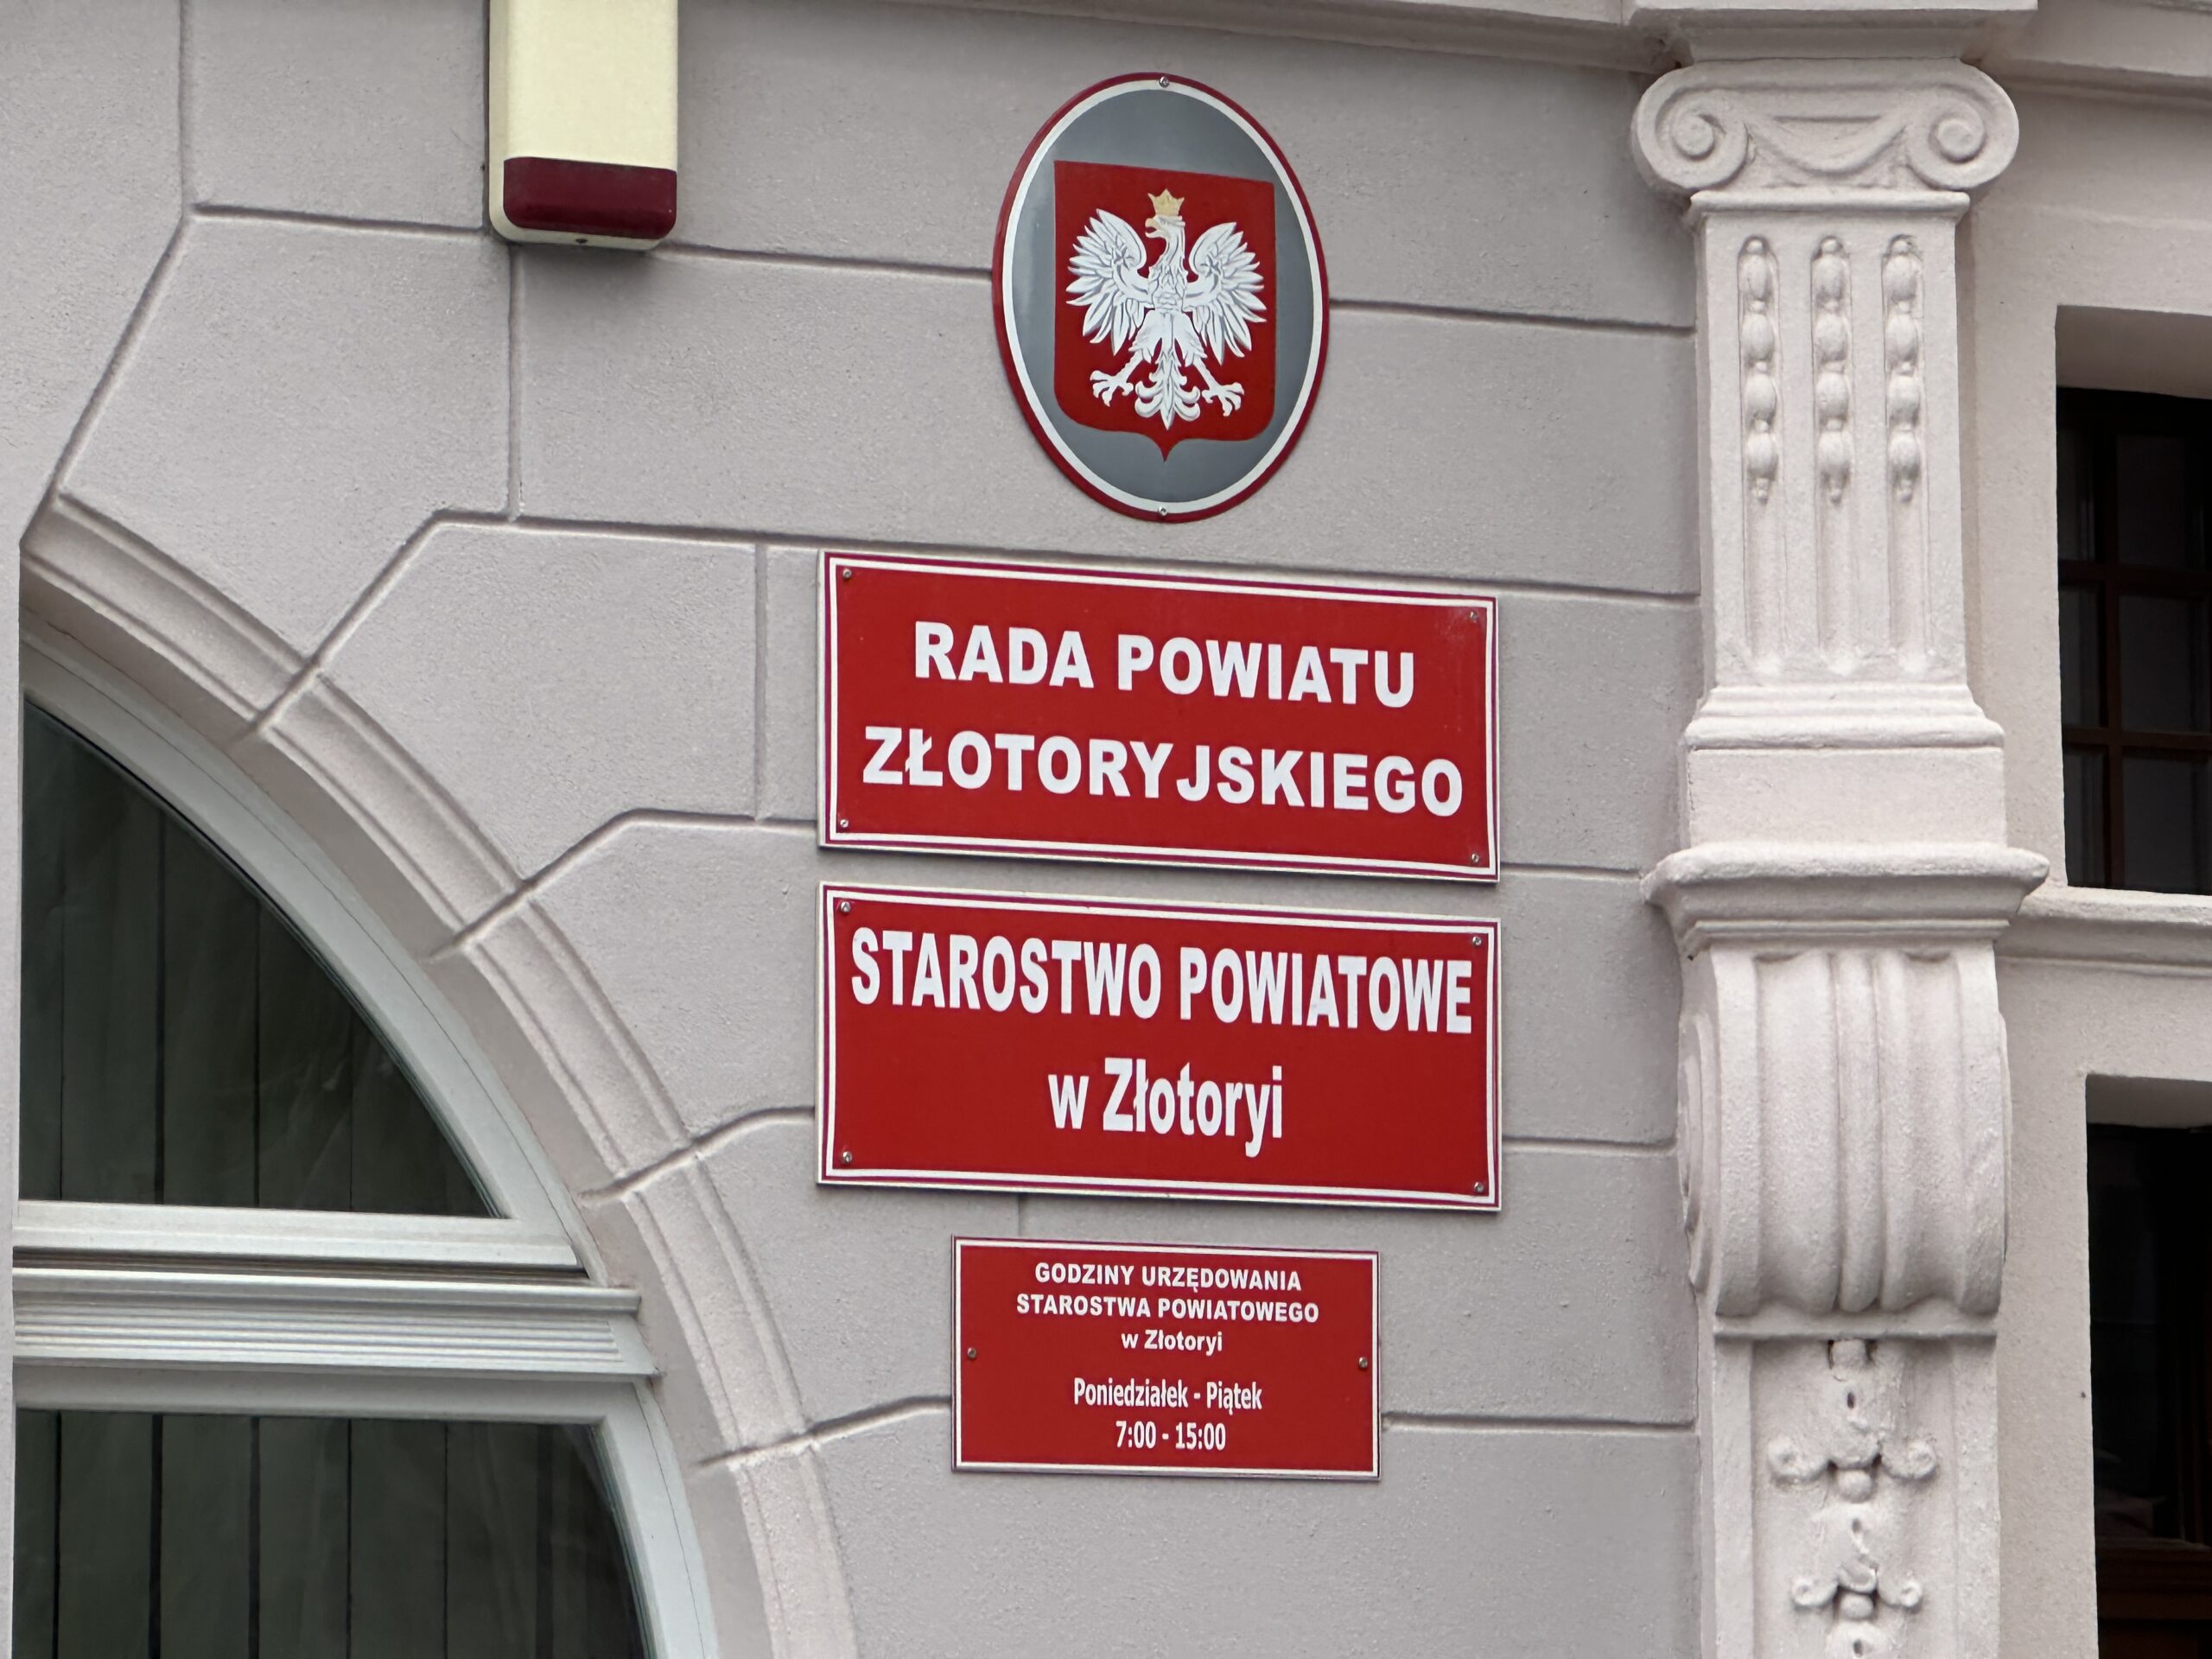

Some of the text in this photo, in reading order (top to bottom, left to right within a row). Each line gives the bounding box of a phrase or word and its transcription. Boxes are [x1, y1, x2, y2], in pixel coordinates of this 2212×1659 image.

[916, 621, 1414, 708] RADA POWIATU
[863, 727, 1462, 817] ZŁOTORYJSKIEGO
[852, 927, 1471, 1033] STAROSTWO POWIATOWE
[1048, 1058, 1281, 1157] w Złotoryi
[1035, 1262, 1301, 1293] GODZINY URZĘDOWANIA
[1017, 1294, 1319, 1322] STAROSTWA POWIATOWEGO
[1122, 1330, 1222, 1356] w Złotoryi
[1074, 1377, 1188, 1408] Poniedziałek
[1207, 1381, 1262, 1415] Piątek
[1116, 1421, 1156, 1448] 7:00
[1176, 1422, 1225, 1450] 15:00
